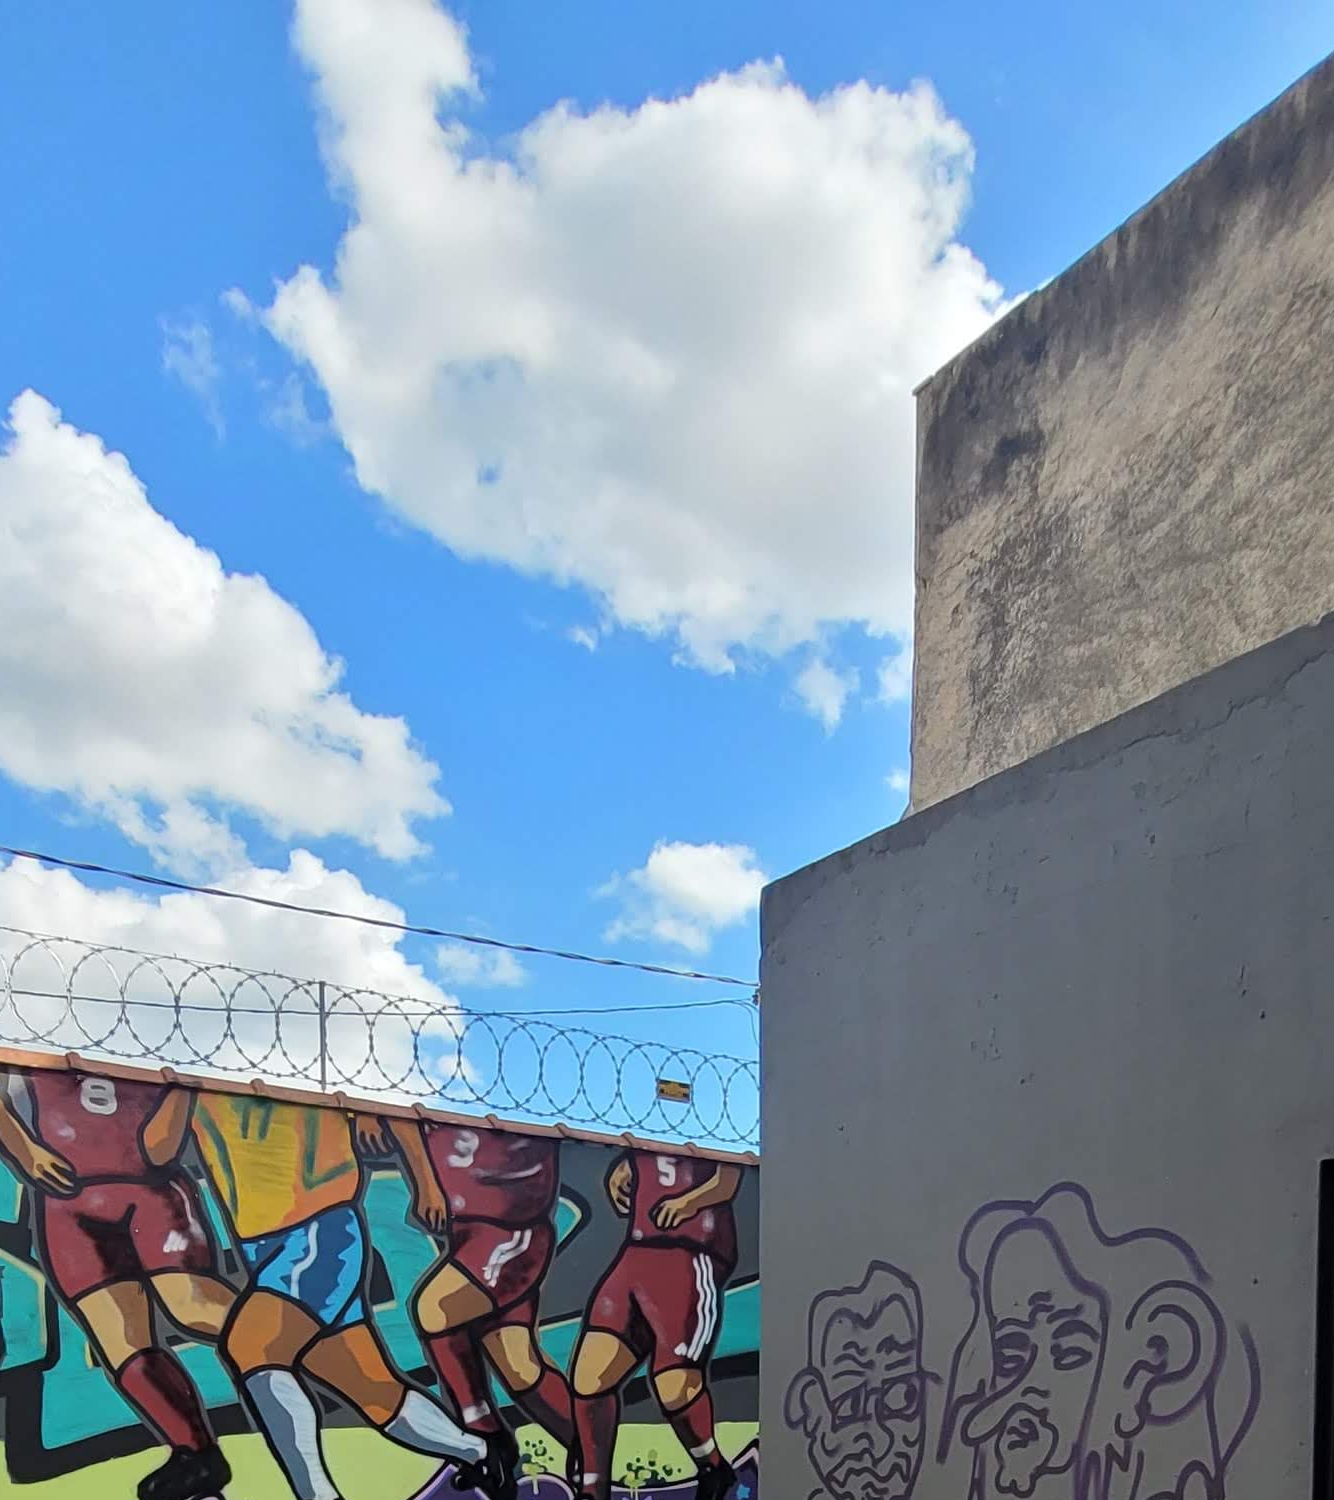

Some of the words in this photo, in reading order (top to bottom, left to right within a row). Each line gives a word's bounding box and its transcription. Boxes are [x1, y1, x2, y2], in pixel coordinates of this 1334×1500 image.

[80, 1078, 118, 1115] 8
[448, 1130, 479, 1168] 3
[656, 1156, 676, 1187] 5
